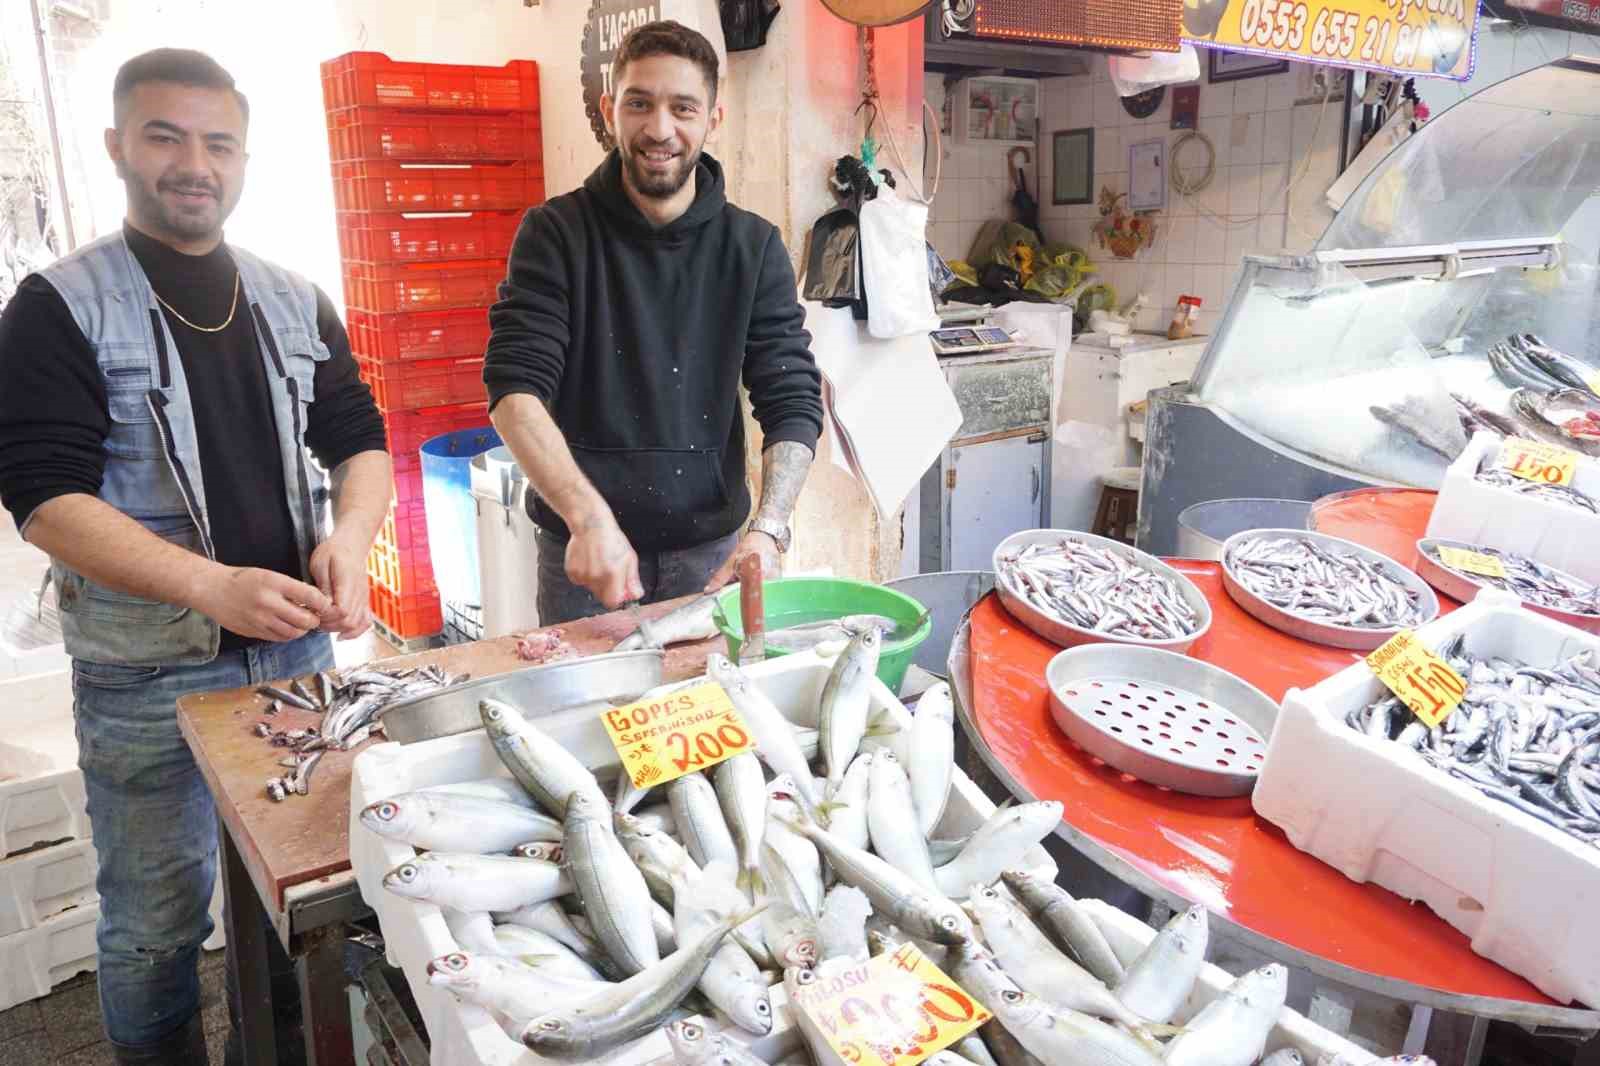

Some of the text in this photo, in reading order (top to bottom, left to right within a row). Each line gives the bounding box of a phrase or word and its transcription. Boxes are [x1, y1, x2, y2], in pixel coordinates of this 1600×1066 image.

[1239, 0, 1308, 49] 0553
[1311, 8, 1360, 57] 655
[1362, 15, 1390, 62] 21
[1406, 662, 1466, 717] 150
[666, 723, 748, 772] 200
